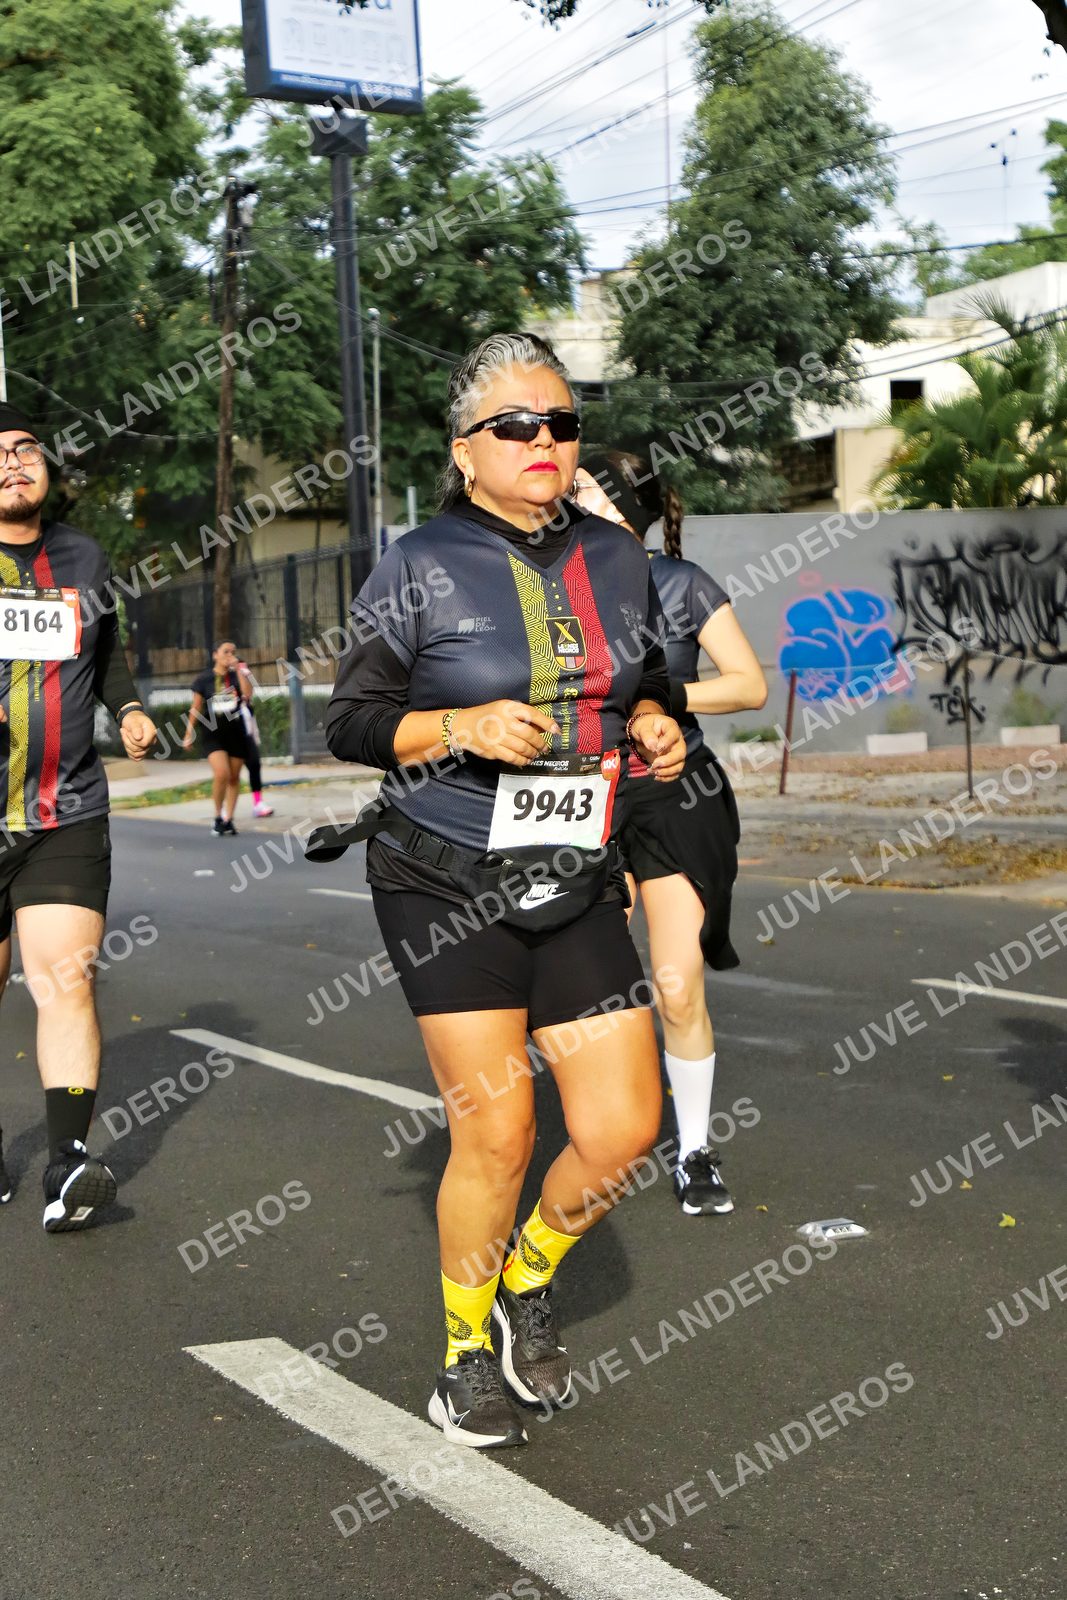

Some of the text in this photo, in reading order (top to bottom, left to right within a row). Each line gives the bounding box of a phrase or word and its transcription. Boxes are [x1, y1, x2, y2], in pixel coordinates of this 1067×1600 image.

[3, 608, 63, 633] 8164
[602, 758, 616, 769] 10K
[513, 788, 594, 822] 9943
[527, 883, 560, 898] NIKE
